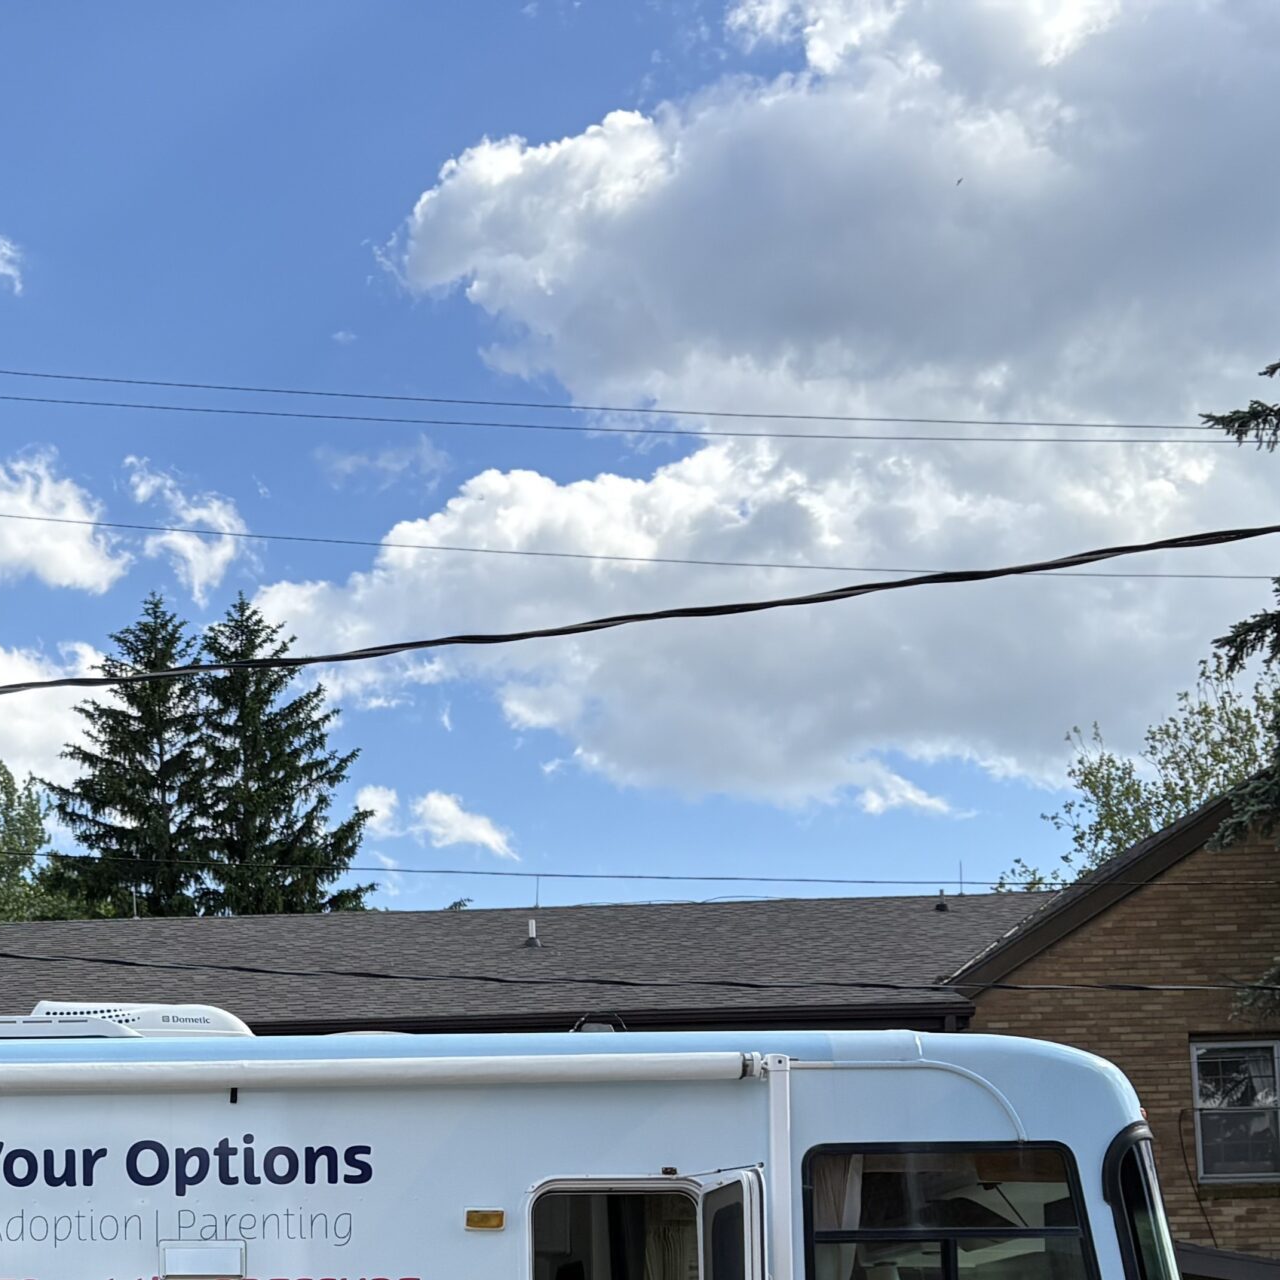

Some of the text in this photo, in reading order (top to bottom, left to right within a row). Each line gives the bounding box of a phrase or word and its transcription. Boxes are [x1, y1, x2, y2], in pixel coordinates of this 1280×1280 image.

[172, 1016, 211, 1024] Dometic
[125, 1133, 374, 1197] Options
[177, 1206, 354, 1247] Parenting
